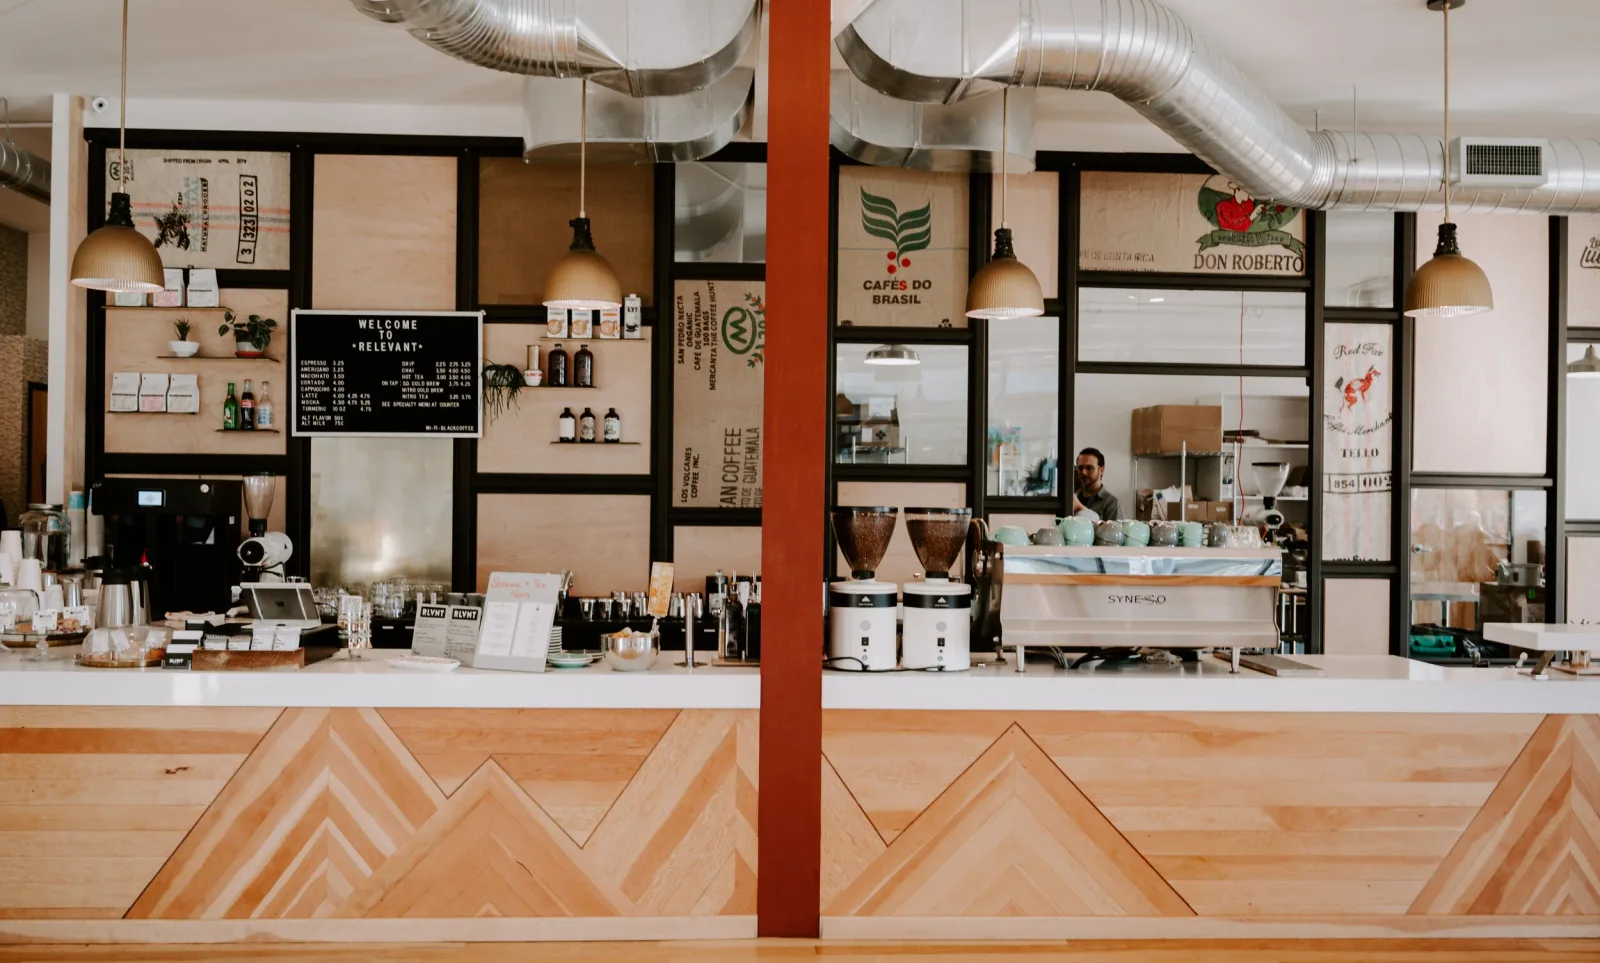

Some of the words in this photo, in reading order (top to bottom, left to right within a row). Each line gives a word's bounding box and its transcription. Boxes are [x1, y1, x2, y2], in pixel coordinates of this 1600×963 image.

[1193, 254, 1228, 270] DON
[1232, 254, 1304, 272] ROBERTO
[912, 280, 932, 290] DO
[872, 295, 921, 304] BRASIL
[359, 320, 417, 329] WELCOME
[379, 331, 393, 339] TO
[359, 342, 417, 351] RELEVANT
[695, 340, 701, 350] DE
[1334, 344, 1361, 359] Red
[722, 428, 742, 482] COFFEE
[743, 427, 759, 484] GUATEMALA
[683, 447, 692, 487] VOLCANES
[691, 472, 699, 498] COFFEE
[422, 608, 444, 617] RLVNT
[453, 610, 476, 619] RLVNT
